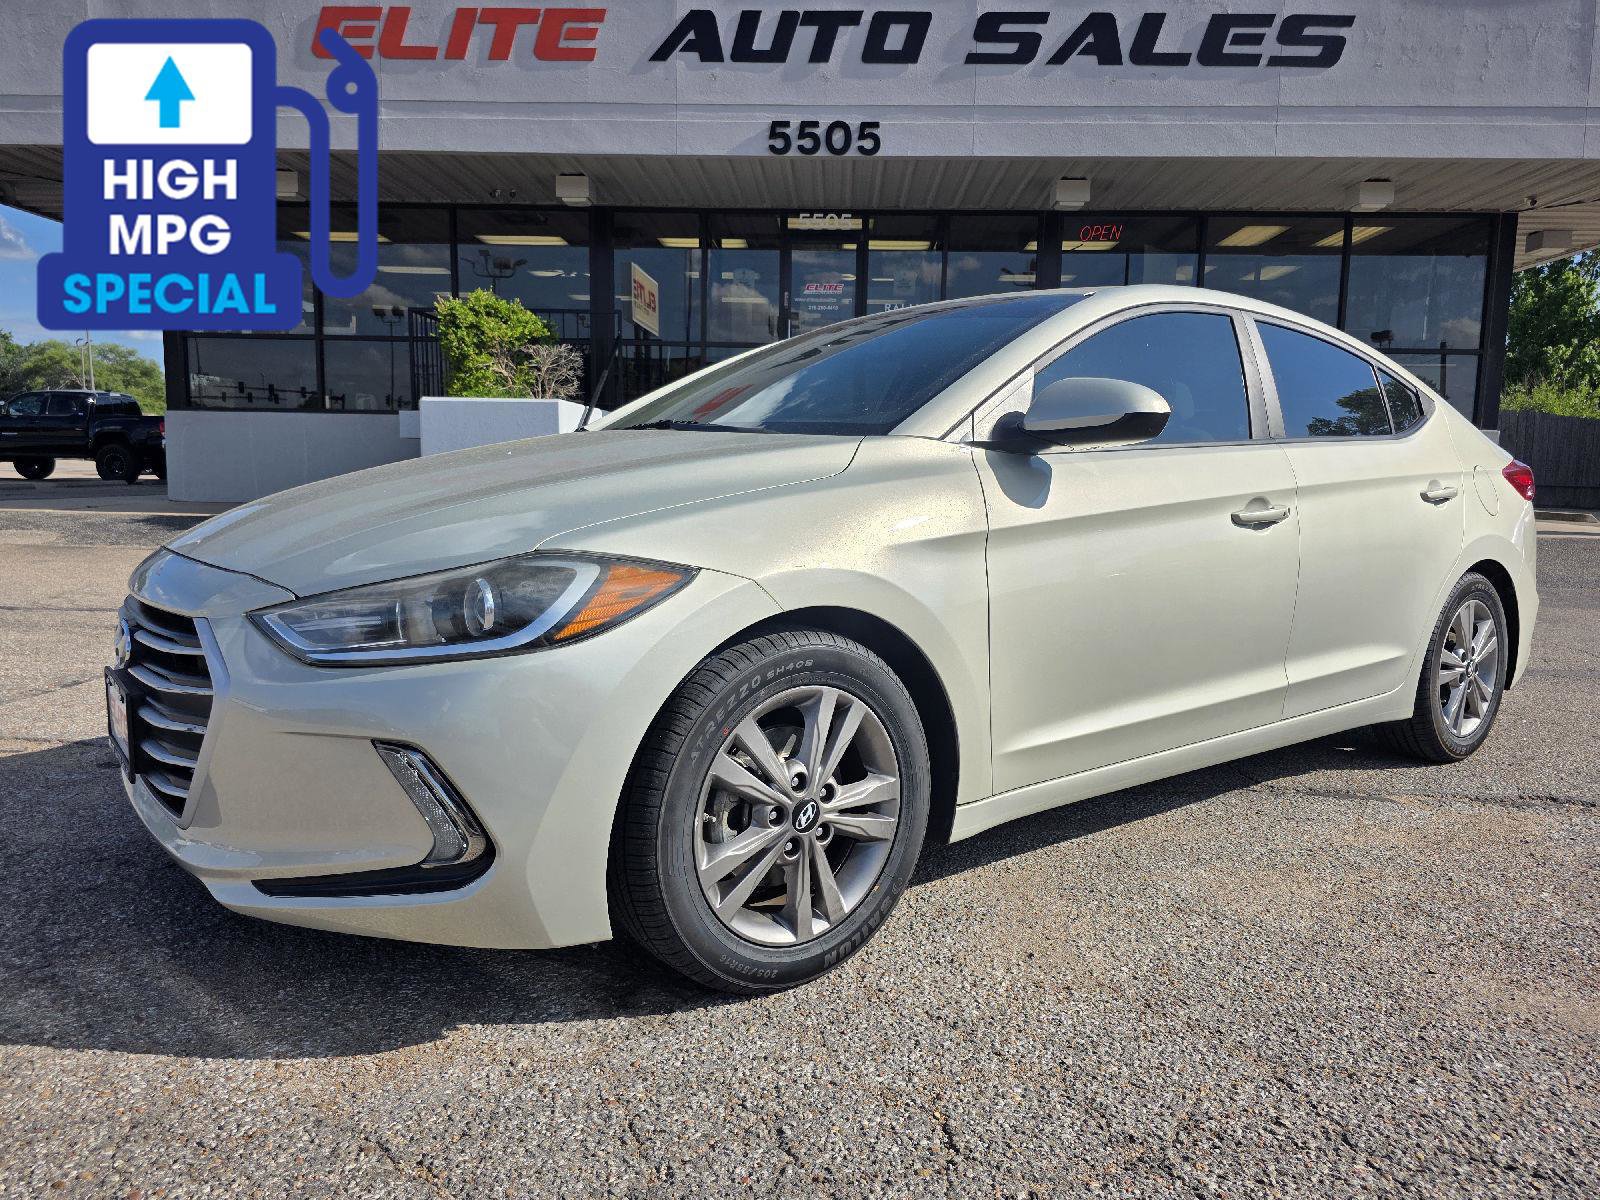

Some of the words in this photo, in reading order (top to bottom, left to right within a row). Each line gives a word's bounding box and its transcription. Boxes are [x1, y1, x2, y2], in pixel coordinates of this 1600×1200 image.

[310, 7, 606, 62] ELITE
[648, 9, 932, 64] AUTO
[964, 11, 1356, 69] SALES
[767, 120, 882, 156] 5505
[799, 213, 852, 231] 5505
[1079, 224, 1123, 242] OPEN
[805, 283, 845, 292] ELITE
[690, 674, 762, 769] ATREZZO
[822, 894, 893, 968] SAILUN
[719, 953, 779, 980] 205/55R16
